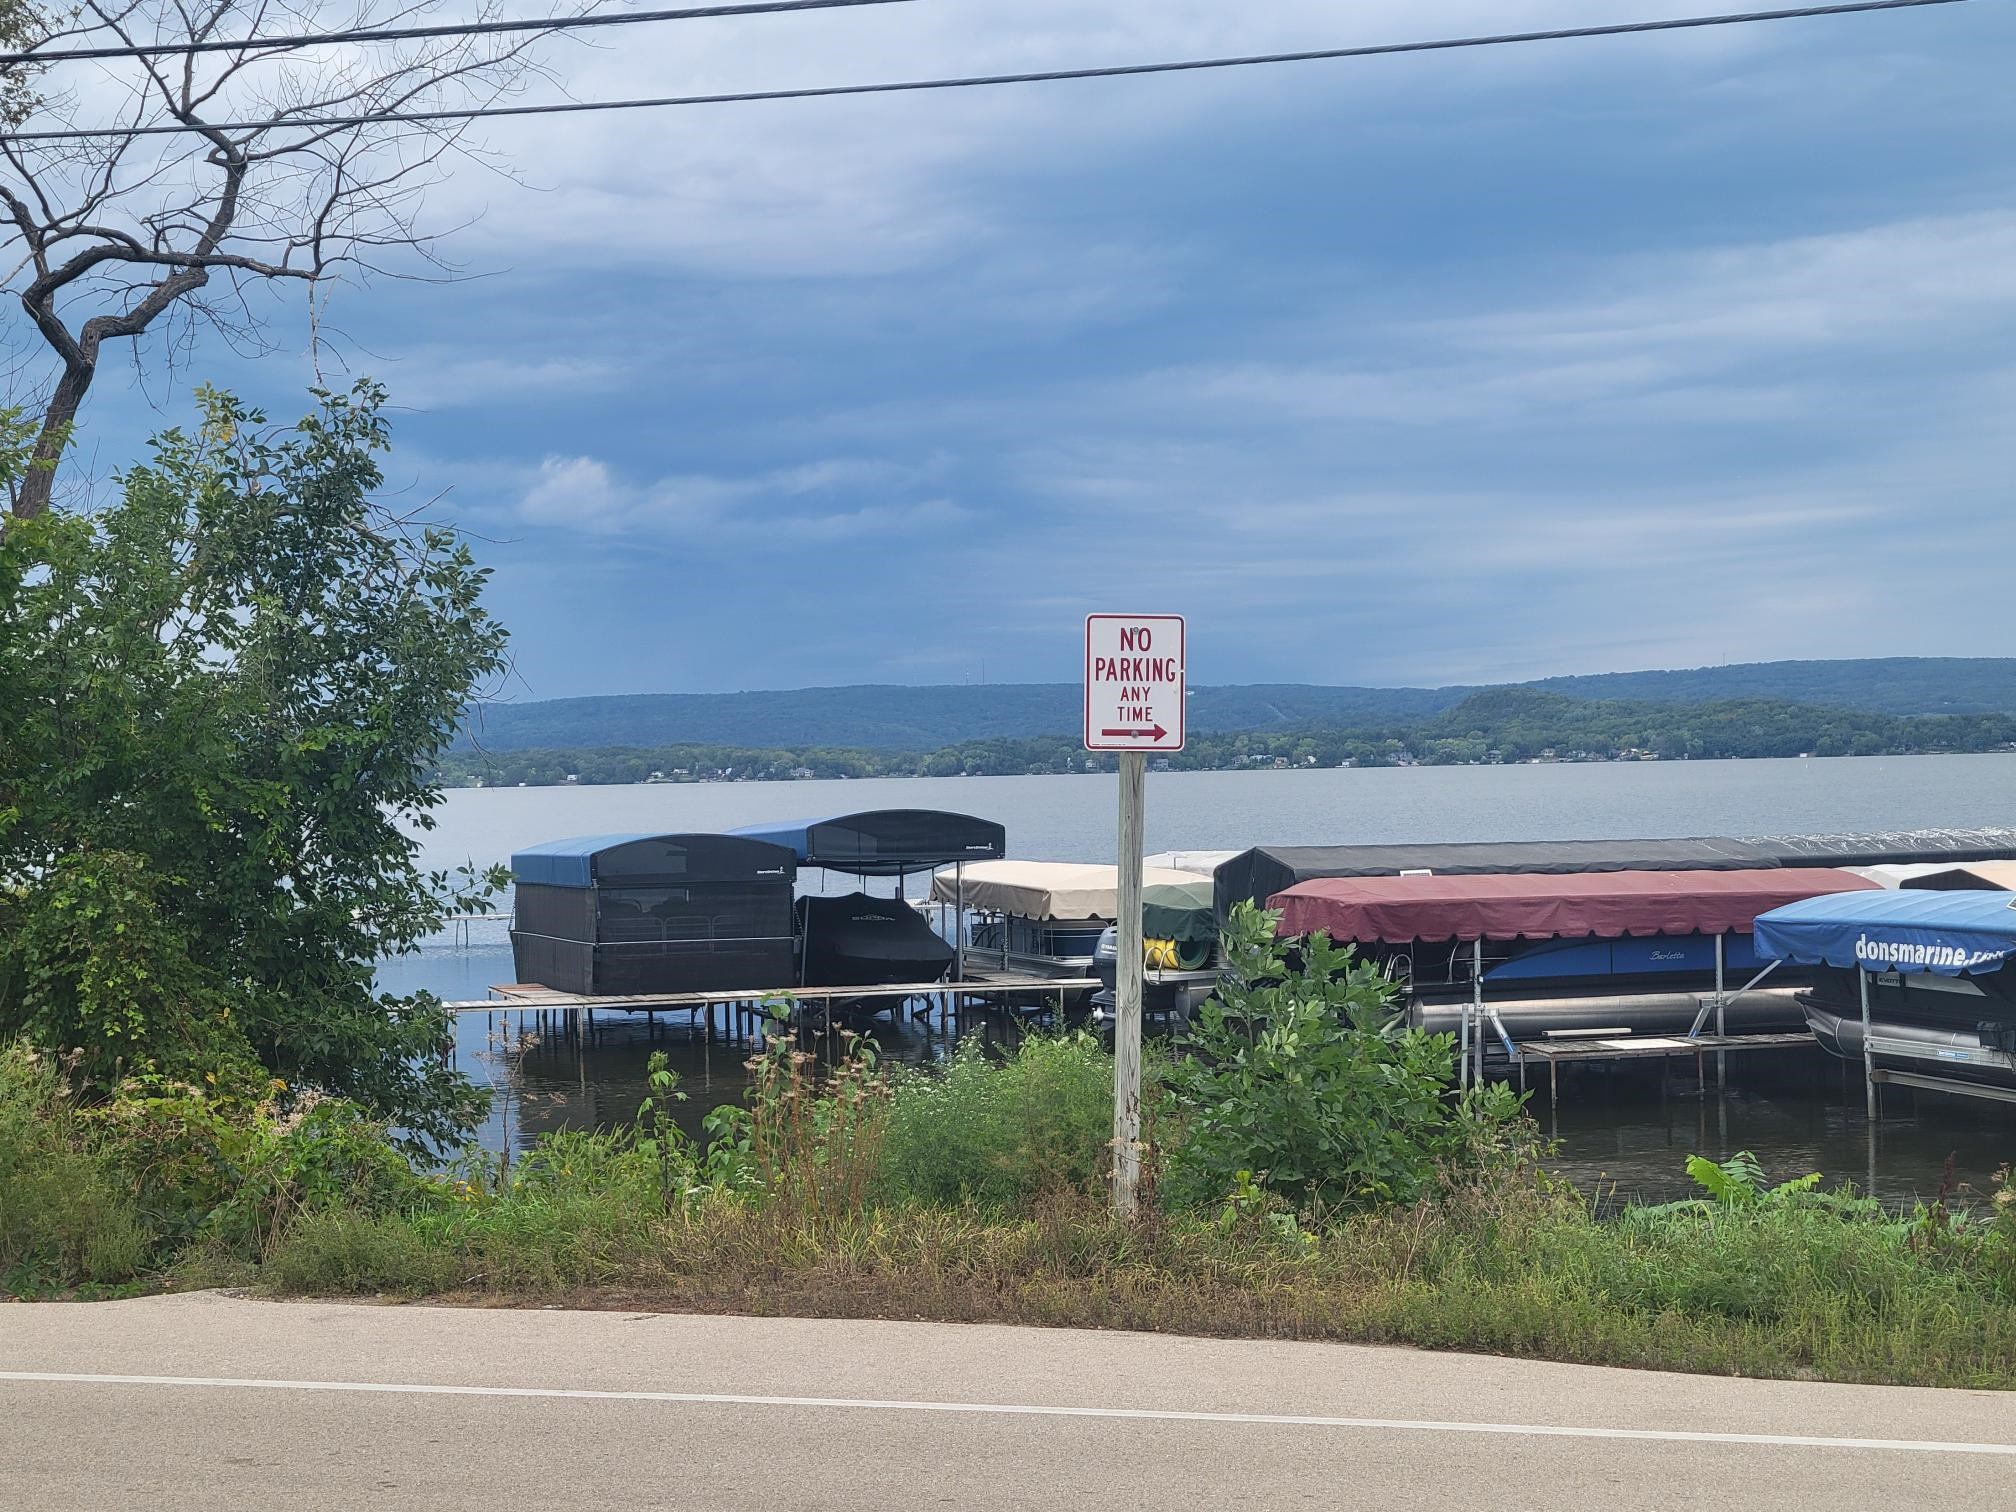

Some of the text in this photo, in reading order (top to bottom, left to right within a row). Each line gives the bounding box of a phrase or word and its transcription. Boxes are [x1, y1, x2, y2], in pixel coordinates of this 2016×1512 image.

[1120, 627, 1152, 652] NO
[1095, 657, 1176, 683] PARKING
[1120, 686, 1151, 702] ANY
[1117, 706, 1153, 722] TIME
[1649, 950, 1685, 961] Barletta
